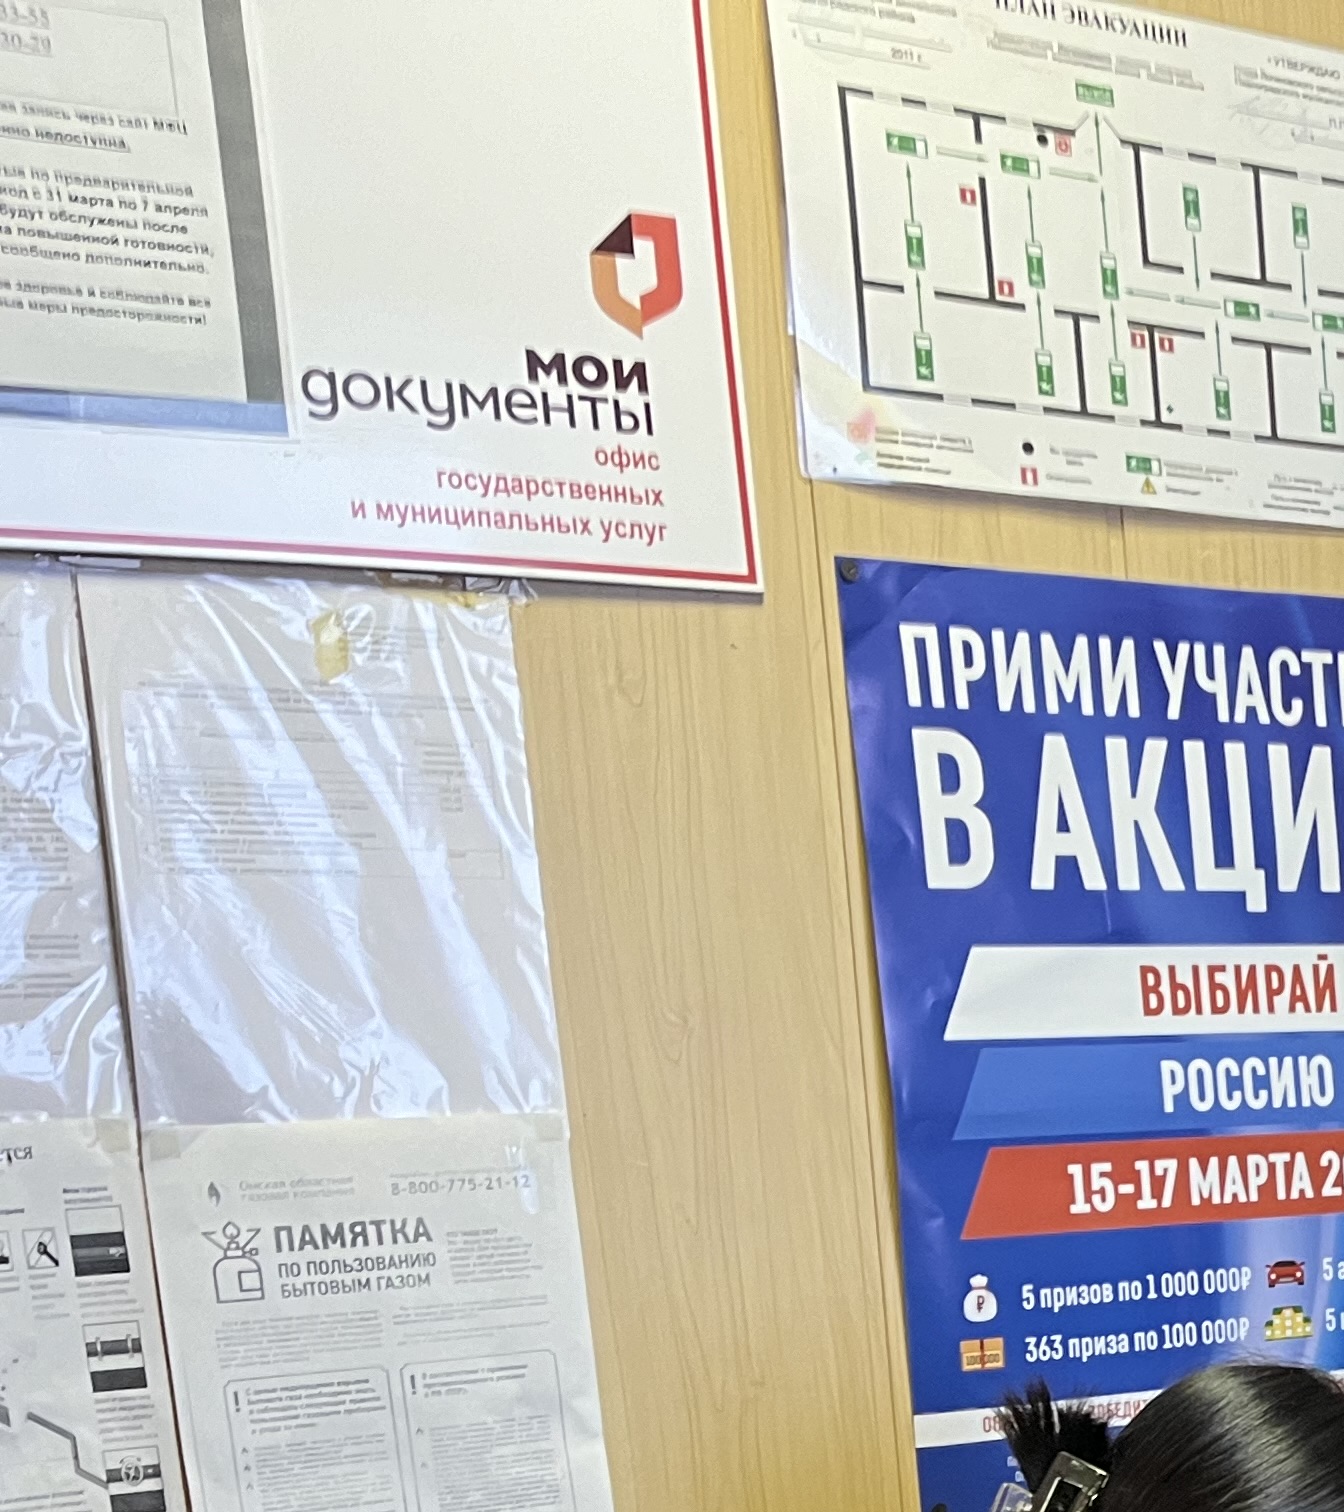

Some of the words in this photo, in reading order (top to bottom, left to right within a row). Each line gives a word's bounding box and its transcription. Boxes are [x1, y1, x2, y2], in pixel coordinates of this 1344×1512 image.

[1062, 3, 1187, 48] ЭВАКУАЦИИ
[17, 225, 120, 247] повышенной
[49, 208, 139, 229] обслужены
[142, 220, 189, 235] после
[300, 365, 655, 438] документы
[593, 444, 662, 474] офис
[435, 466, 666, 508] государственных
[350, 499, 368, 520] и
[375, 500, 593, 538] муниципальных
[600, 519, 669, 548] услуг
[899, 621, 1141, 718] ПРИМИ
[911, 725, 995, 890] В
[1138, 953, 1339, 1018] ВЫБИРАЙ
[1160, 1054, 1335, 1114] РОССИЮ
[1067, 1158, 1180, 1216] 15-17
[1189, 1151, 1315, 1207] МАРТА
[274, 1217, 433, 1254] ПАМЯТКА
[277, 1262, 301, 1279] ПО
[307, 1251, 437, 1277] ПОЛЬЗОВАНИЮ
[281, 1277, 372, 1299] БЫТОВЫМ
[376, 1273, 431, 1292] ГАЗОМ
[1322, 1256, 1335, 1282] 5
[1021, 1283, 1035, 1311] 5
[1039, 1283, 1114, 1313] призов
[1118, 1279, 1143, 1303] по
[1146, 1274, 1158, 1299] 1
[1160, 1270, 1200, 1298] 000
[1324, 1307, 1337, 1333] 5
[1024, 1333, 1064, 1363] 363
[1068, 1333, 1129, 1363] приза
[1133, 1329, 1159, 1352] по
[1161, 1321, 1198, 1350] 100
